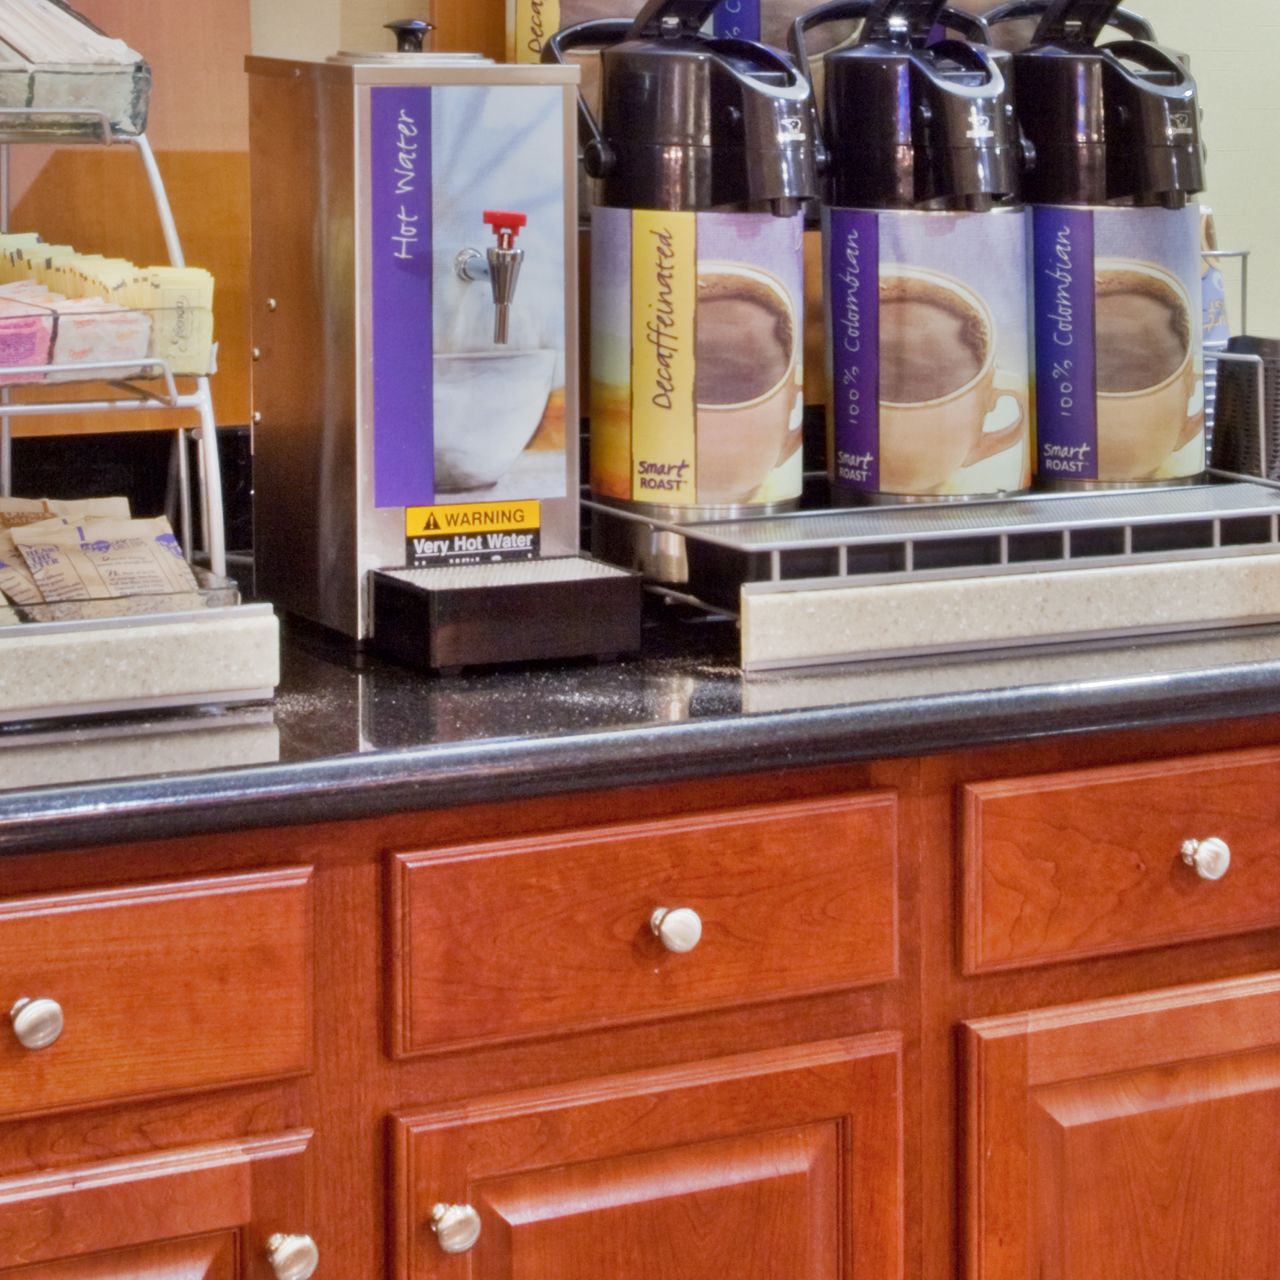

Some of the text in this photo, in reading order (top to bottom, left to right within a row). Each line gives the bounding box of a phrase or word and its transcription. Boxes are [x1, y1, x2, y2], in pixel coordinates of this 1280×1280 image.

[391, 108, 418, 259] Hot Water
[646, 227, 679, 410] Decaffeinated
[838, 229, 860, 424] 100% Colombian
[1045, 225, 1073, 417] 100% Colombian
[838, 468, 868, 482] ROAST
[1045, 459, 1084, 472] ROAST
[640, 476, 682, 491] ROAST
[444, 508, 525, 527] WARNING
[413, 533, 534, 557] Very Hot Water
